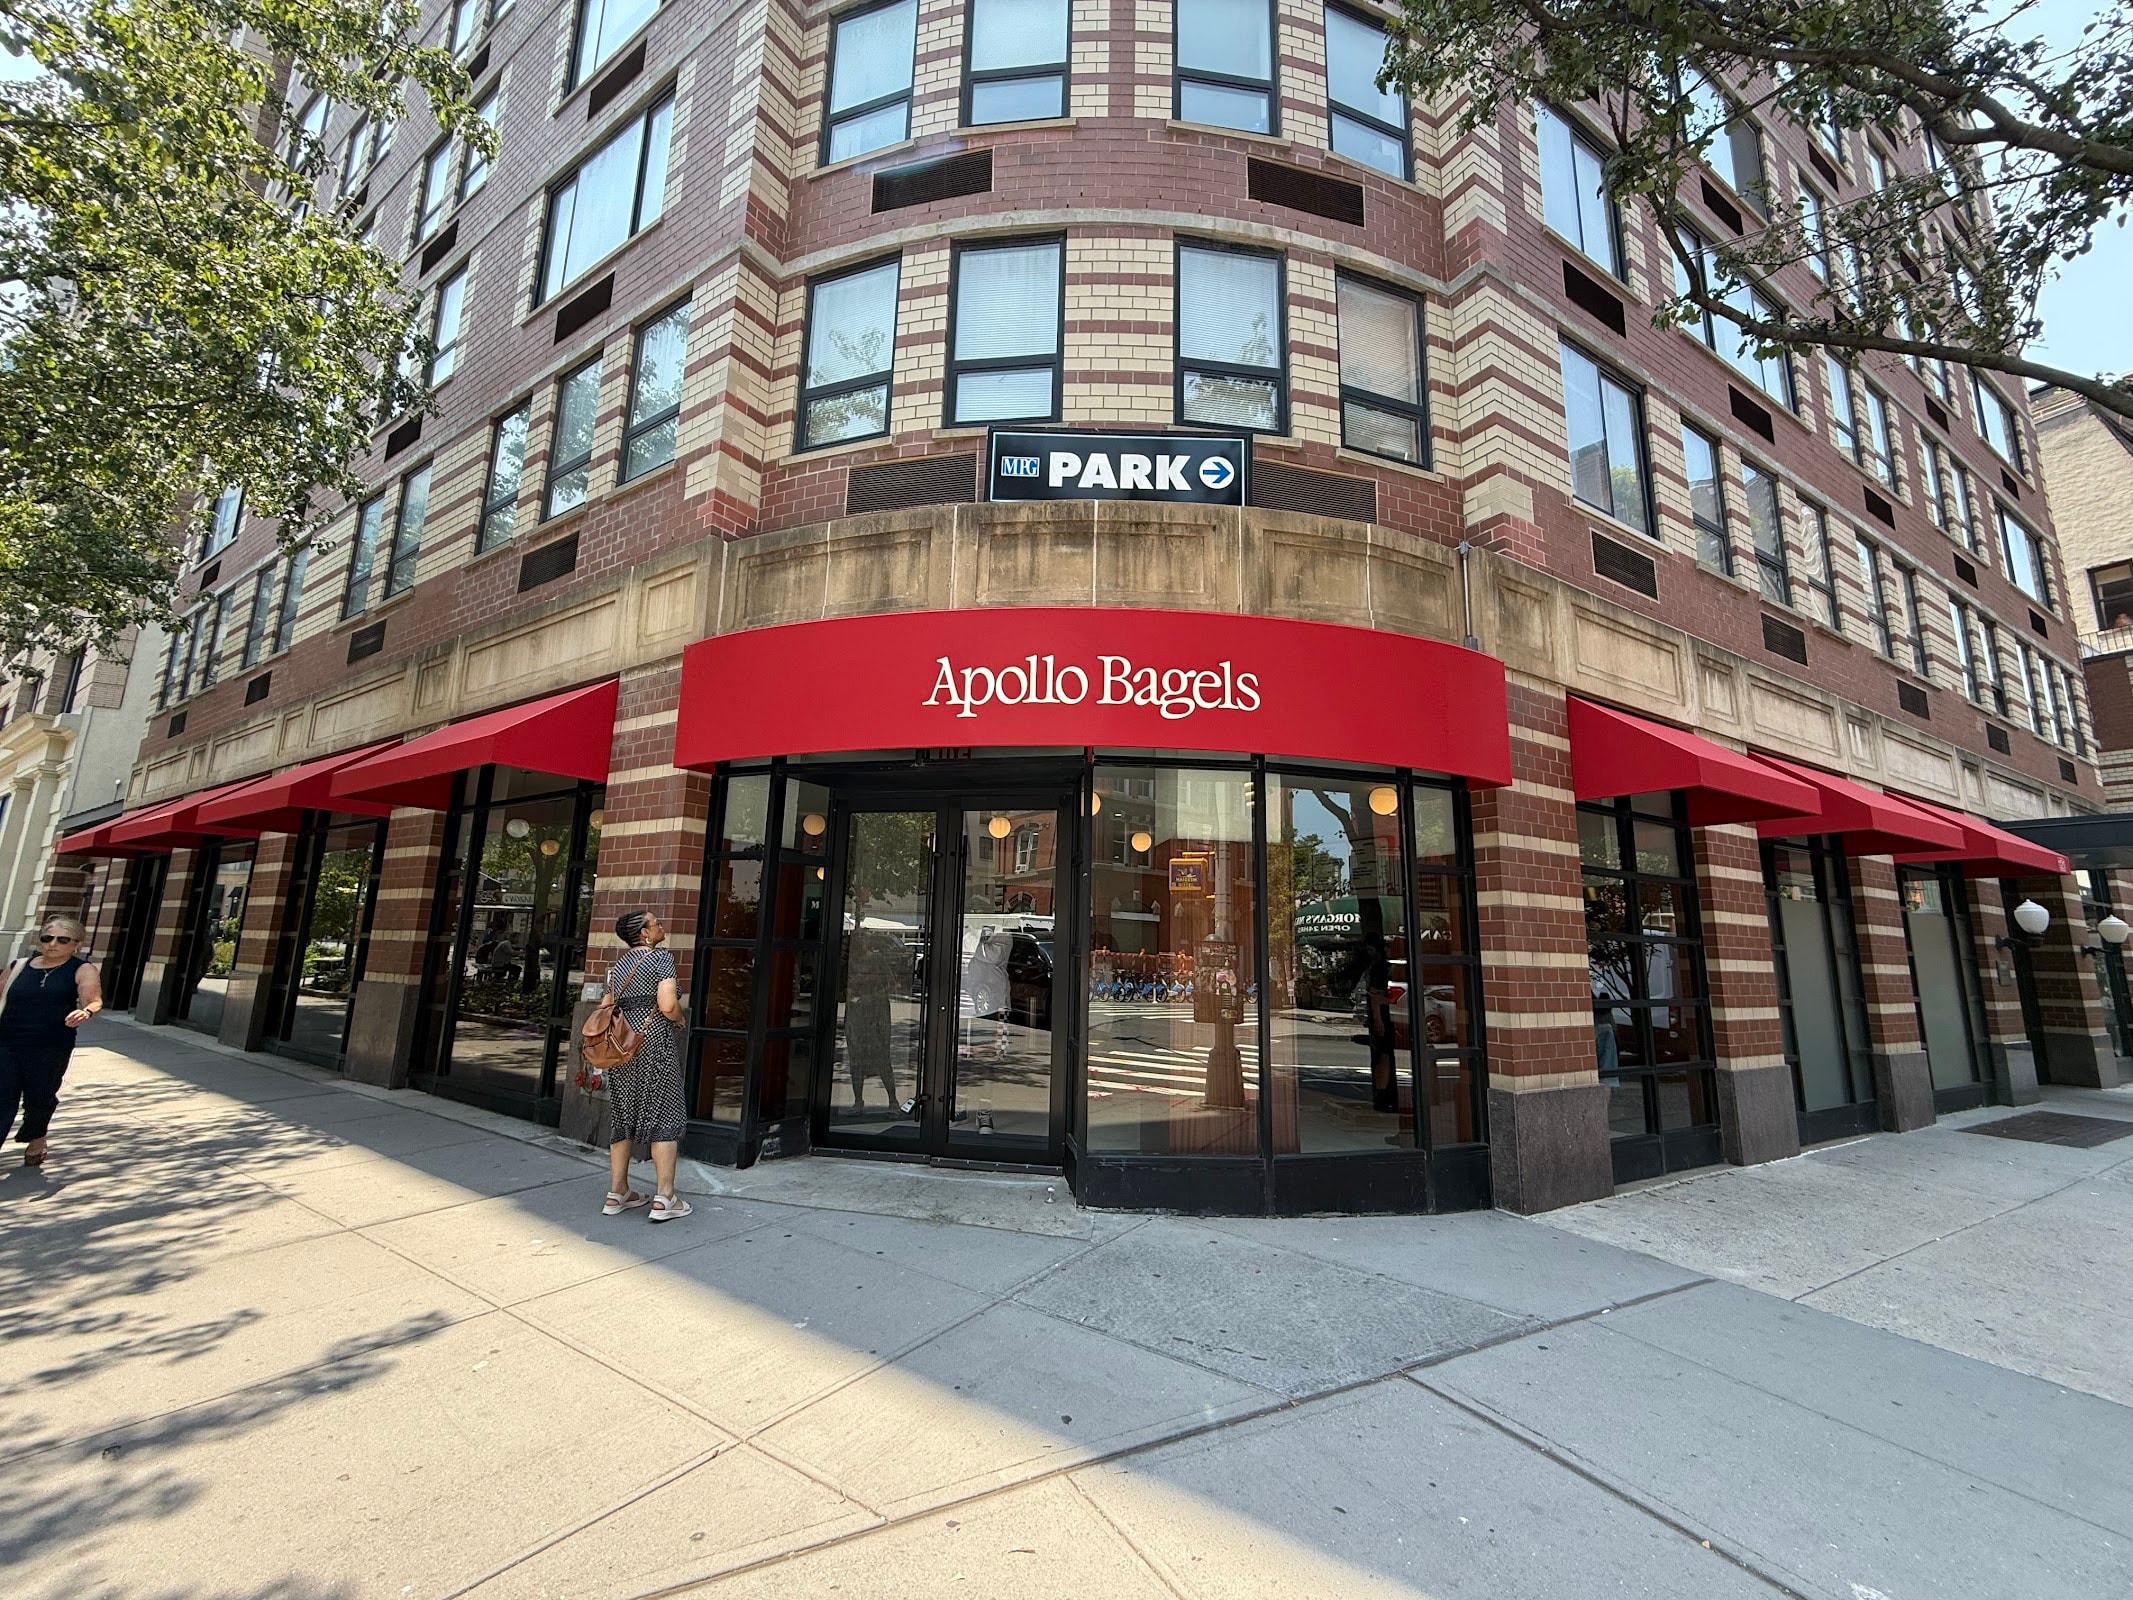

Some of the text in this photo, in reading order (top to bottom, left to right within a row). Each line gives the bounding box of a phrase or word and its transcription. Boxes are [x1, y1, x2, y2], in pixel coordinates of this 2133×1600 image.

[1002, 452, 1192, 491] MPG PARK
[922, 655, 1261, 719] Apollo Bagels
